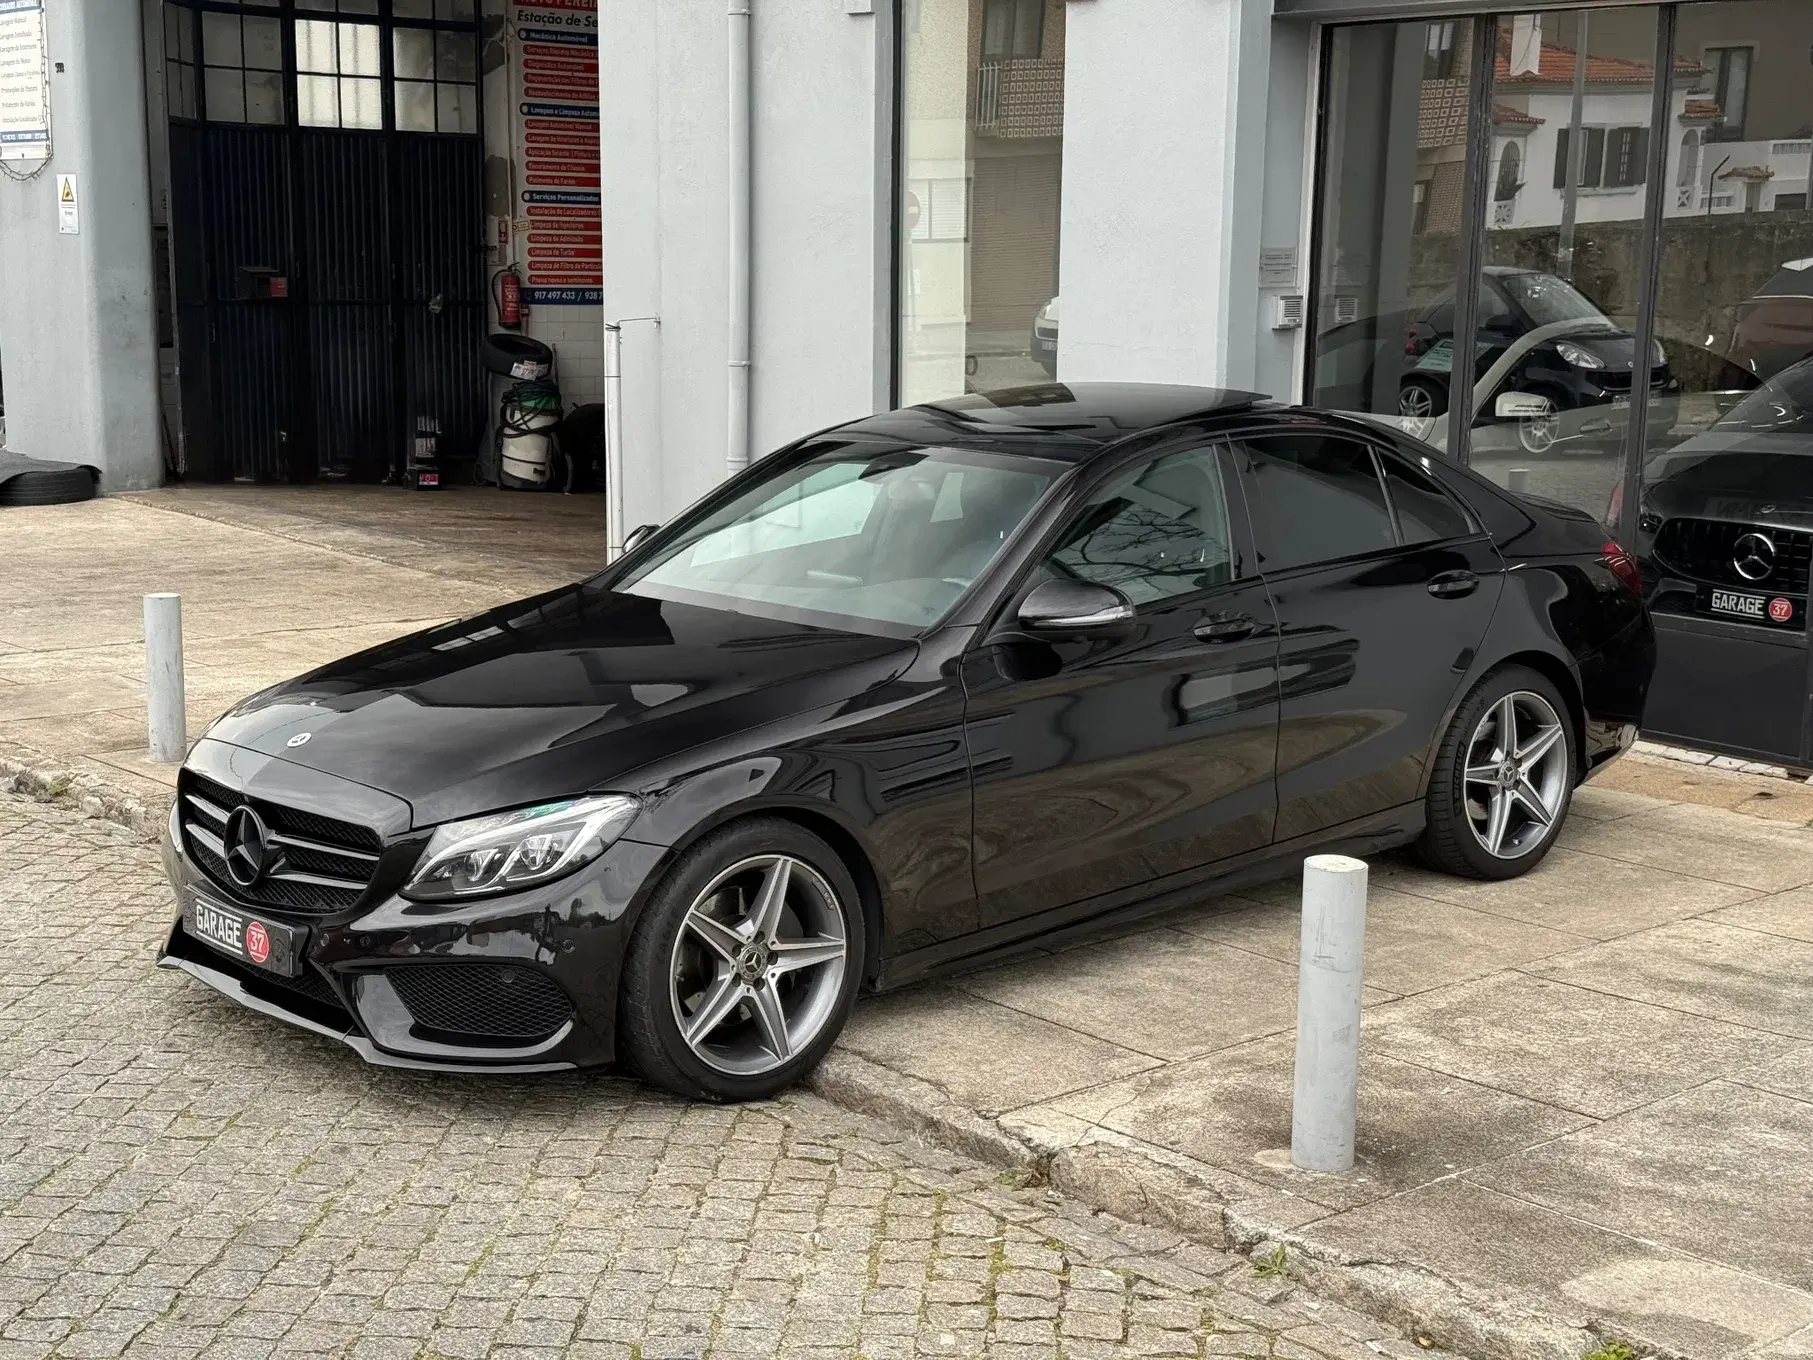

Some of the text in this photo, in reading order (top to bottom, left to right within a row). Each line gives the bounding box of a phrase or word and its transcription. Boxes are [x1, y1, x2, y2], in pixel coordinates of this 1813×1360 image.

[517, 10, 598, 28] Estação de Se
[530, 32, 588, 43] Mecânica Automóvel
[530, 106, 554, 115] Lavagem
[533, 193, 556, 201] Serviços
[534, 291, 545, 300] 917
[547, 291, 560, 300] 497
[562, 291, 575, 300] 433
[585, 292, 597, 300] 938
[1712, 592, 1788, 616] GARAGE 37
[196, 905, 264, 952] GARAGE 37
